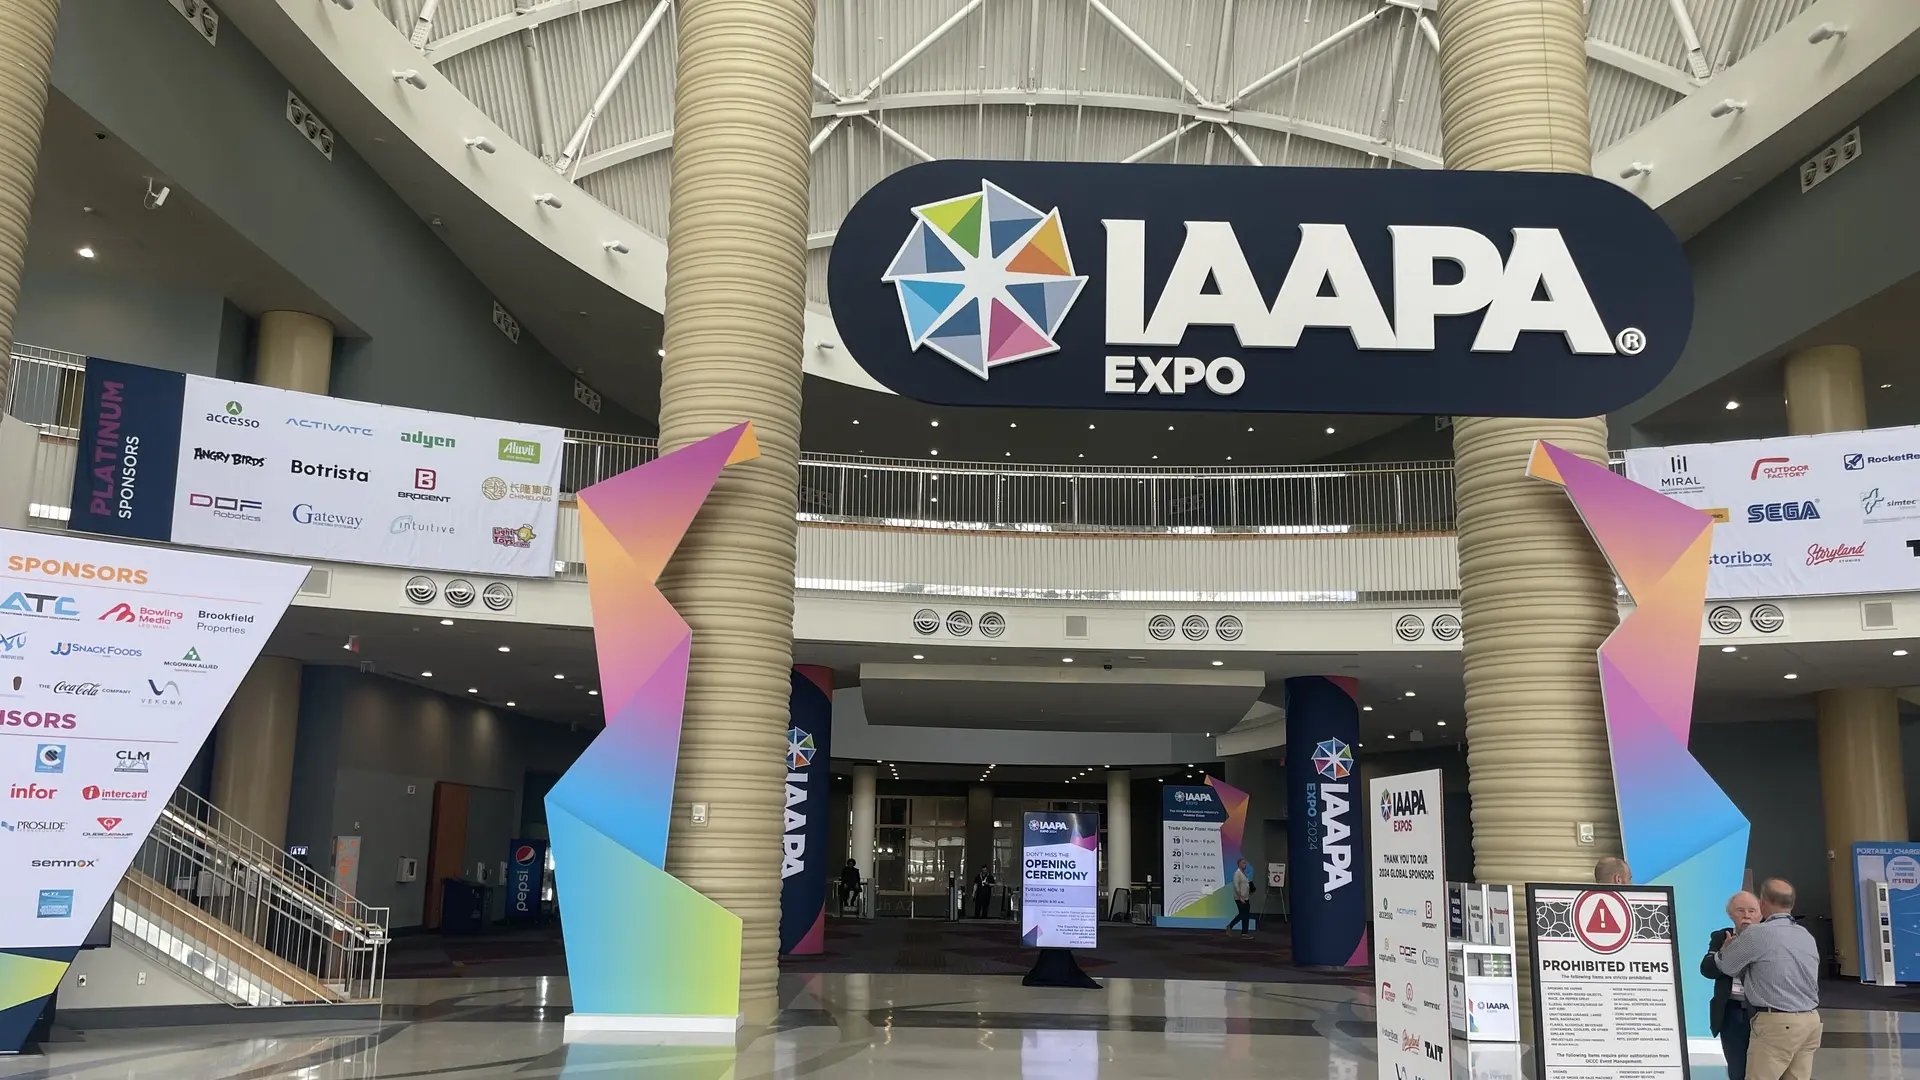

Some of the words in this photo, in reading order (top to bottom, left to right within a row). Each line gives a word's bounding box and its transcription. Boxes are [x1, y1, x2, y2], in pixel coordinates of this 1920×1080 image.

[1102, 219, 1615, 355] IAAPA
[1104, 356, 1245, 396] EXPO
[206, 412, 260, 429] accesso
[285, 417, 374, 436] ACTIVATE
[400, 431, 456, 449] adyen
[90, 379, 124, 516] PLATINUM
[503, 441, 536, 456] Aluvii
[193, 447, 230, 463] ANGRY
[231, 453, 266, 468] BIRDS
[291, 459, 369, 483] Botrista
[1763, 464, 1810, 474] OUTDOOR
[1767, 471, 1806, 479] FACTORY
[118, 435, 139, 519] SPONSORS
[1661, 476, 1701, 487] MIRAL
[189, 493, 262, 512] DOF
[397, 491, 451, 503] BROGENT
[508, 494, 552, 503] CHIMELONG
[1887, 498, 1917, 507] simtec
[213, 510, 261, 522] Robotics
[292, 503, 363, 529] Gateway
[1747, 500, 1821, 523] SEGA
[398, 520, 455, 534] intuitive
[1806, 541, 1866, 566] Storyland
[8, 555, 148, 585] SPONSORS
[0, 591, 80, 616] ATC
[139, 607, 183, 619] Bowling
[198, 610, 254, 623] Brookfield
[139, 615, 171, 625] Media
[196, 622, 246, 634] Properties
[72, 643, 106, 655] SNACK
[107, 646, 142, 658] FOODS
[140, 698, 182, 706] VEKOMA
[116, 750, 150, 761] CLM
[10, 783, 58, 799] infor
[101, 788, 148, 799] intercard
[1185, 792, 1213, 802] IAAPA
[1306, 782, 1317, 817] EXPO
[1392, 789, 1427, 816] IAAPA
[17, 820, 66, 831] PROSLIDE
[781, 772, 809, 880] IAAPA
[1040, 821, 1068, 831] IAAPA
[1393, 820, 1413, 832] EXPOS
[1307, 820, 1319, 851] 2024
[1320, 783, 1353, 893] IAAPA
[292, 847, 306, 855] ATM
[31, 858, 96, 868] semnox
[1025, 859, 1076, 869] OPENING
[1383, 854, 1399, 864] THANK
[1399, 854, 1409, 864] YOU
[1410, 854, 1416, 864] TO
[1417, 854, 1428, 864] OUR
[1025, 870, 1088, 881] CEREMONY
[1379, 868, 1390, 877] 2024
[1390, 868, 1408, 879] GLOBAL
[1408, 869, 1435, 880] SPONSORS
[516, 869, 531, 912] pepsi
[1543, 960, 1625, 973] PROHIBITED
[1629, 962, 1669, 973] ITEMS
[1486, 1002, 1509, 1010] IAAPA
[1424, 1040, 1443, 1062] TAIT
